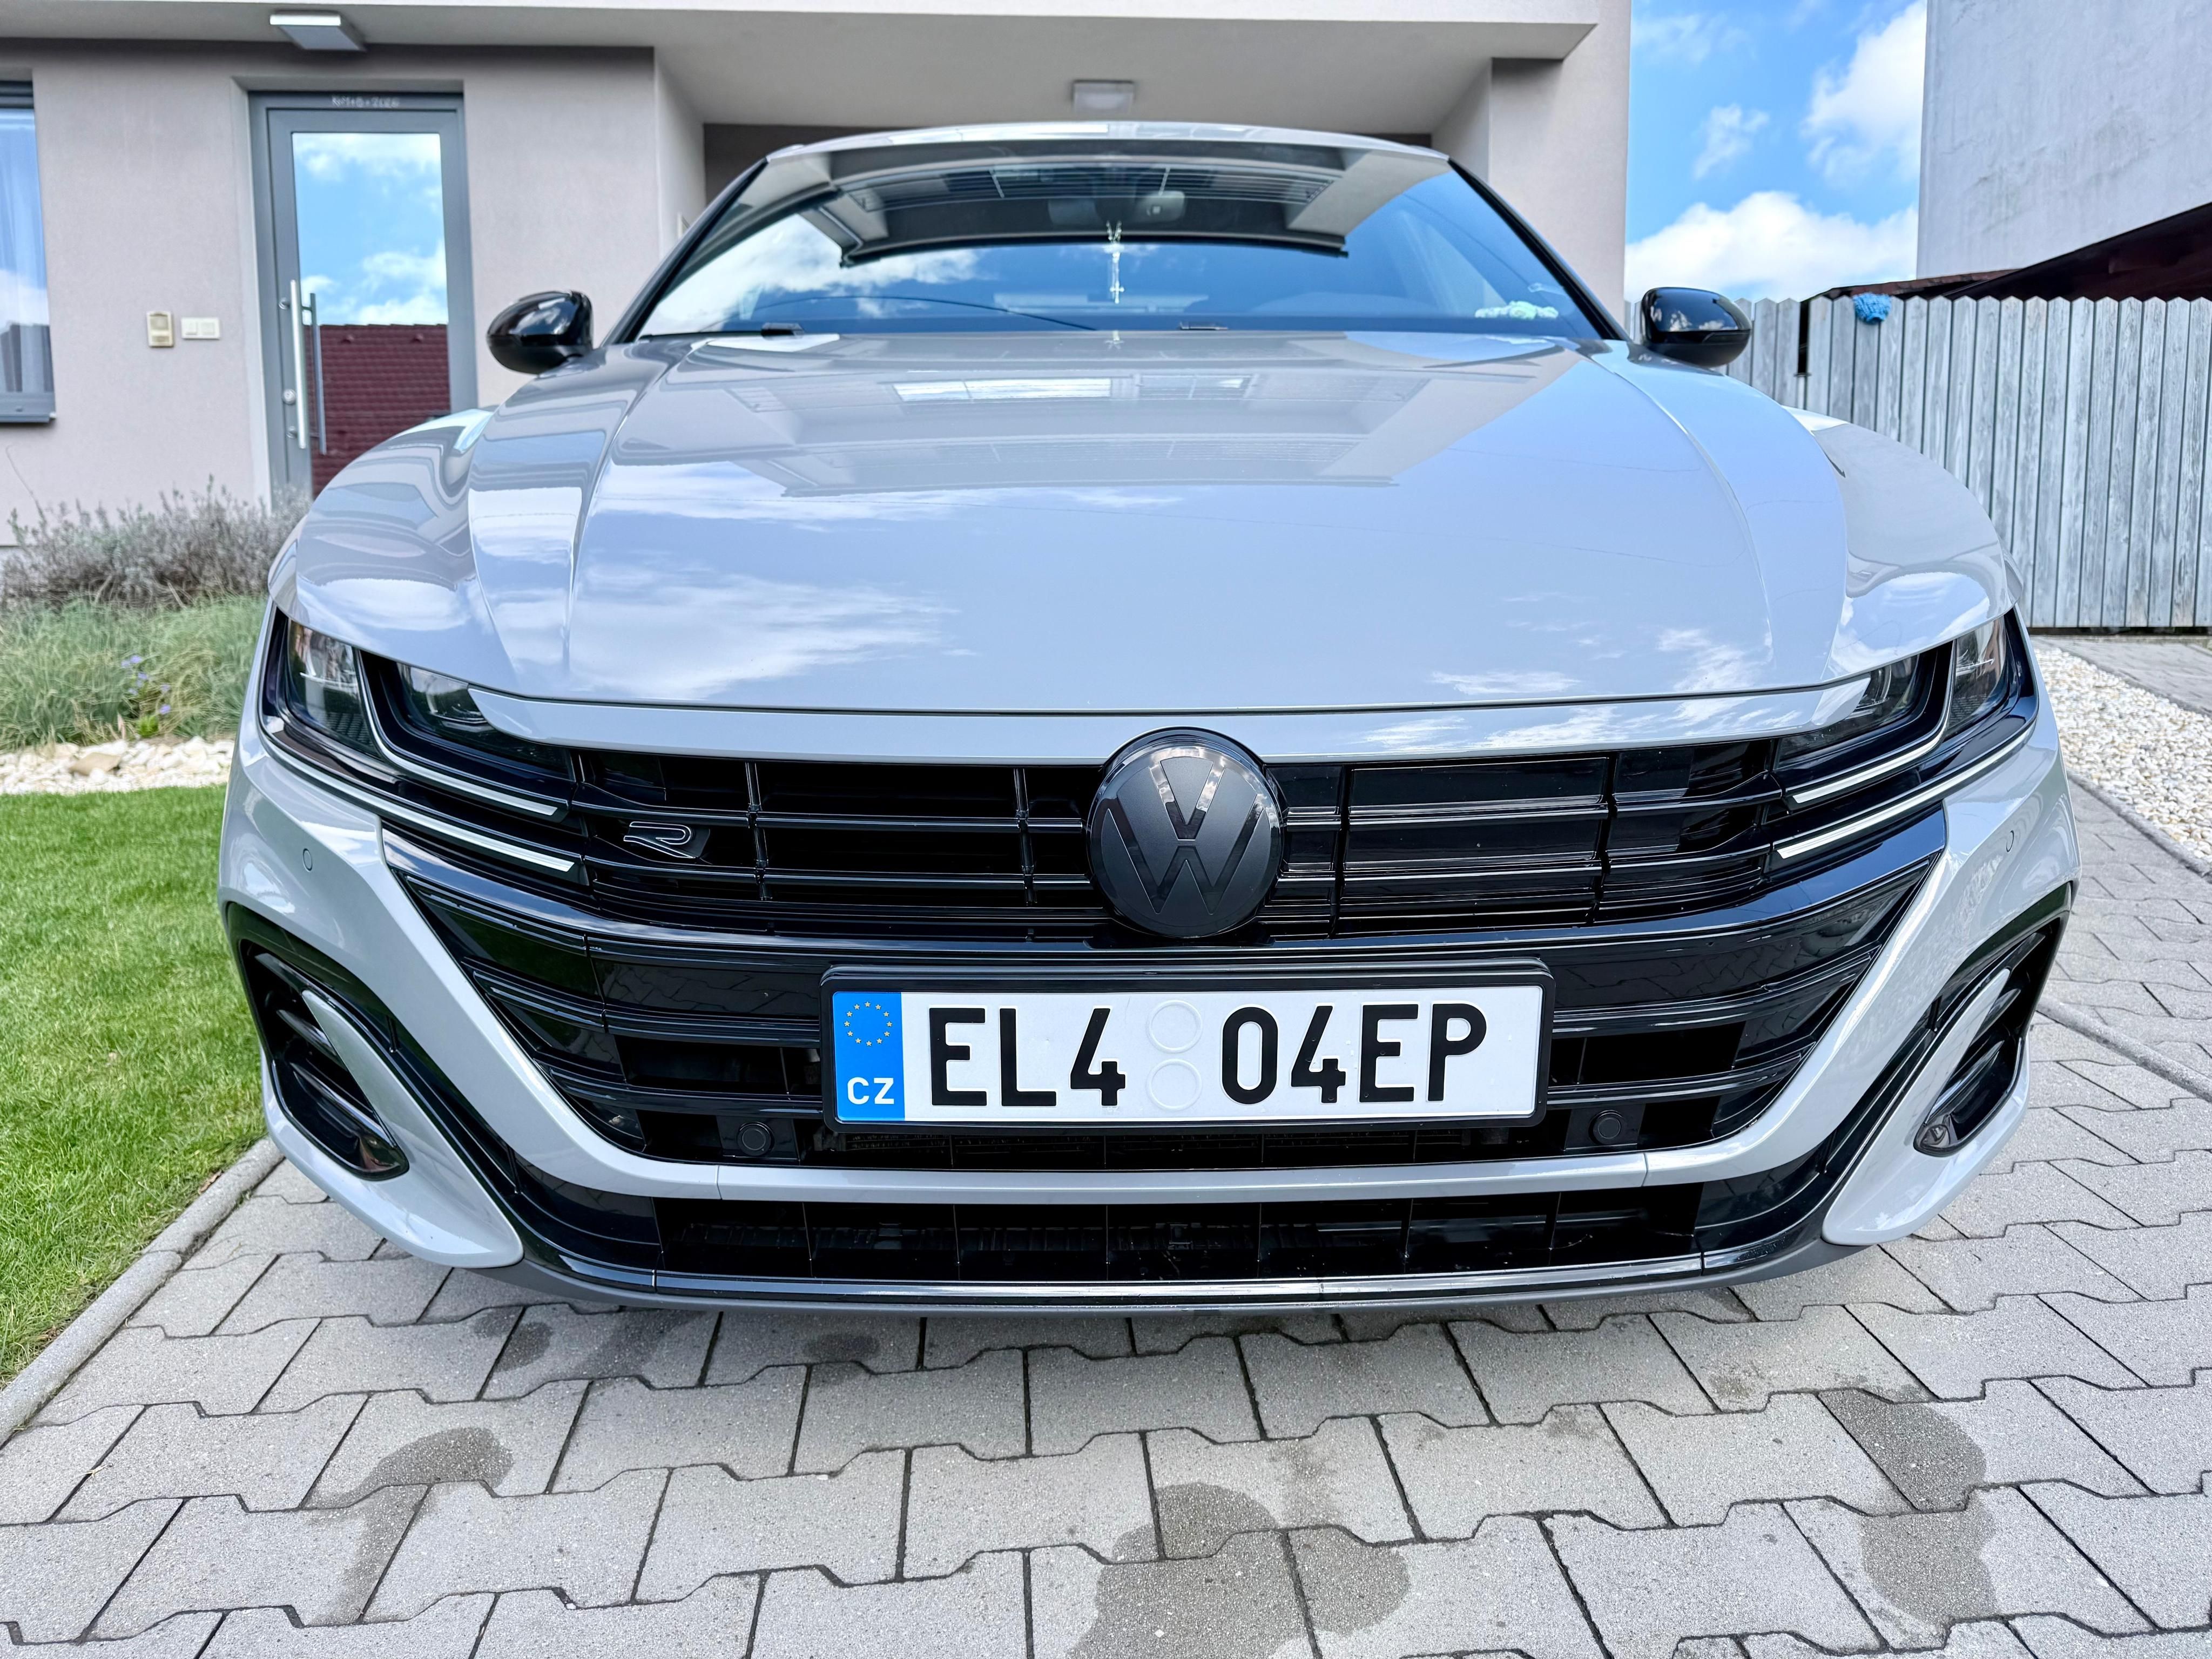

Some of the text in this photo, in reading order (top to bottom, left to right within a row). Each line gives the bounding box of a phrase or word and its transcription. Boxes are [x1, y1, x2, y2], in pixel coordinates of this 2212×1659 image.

[1101, 755, 1269, 915] VW
[847, 1076, 895, 1105] CZ
[928, 1003, 1487, 1107] EL4 04EP
